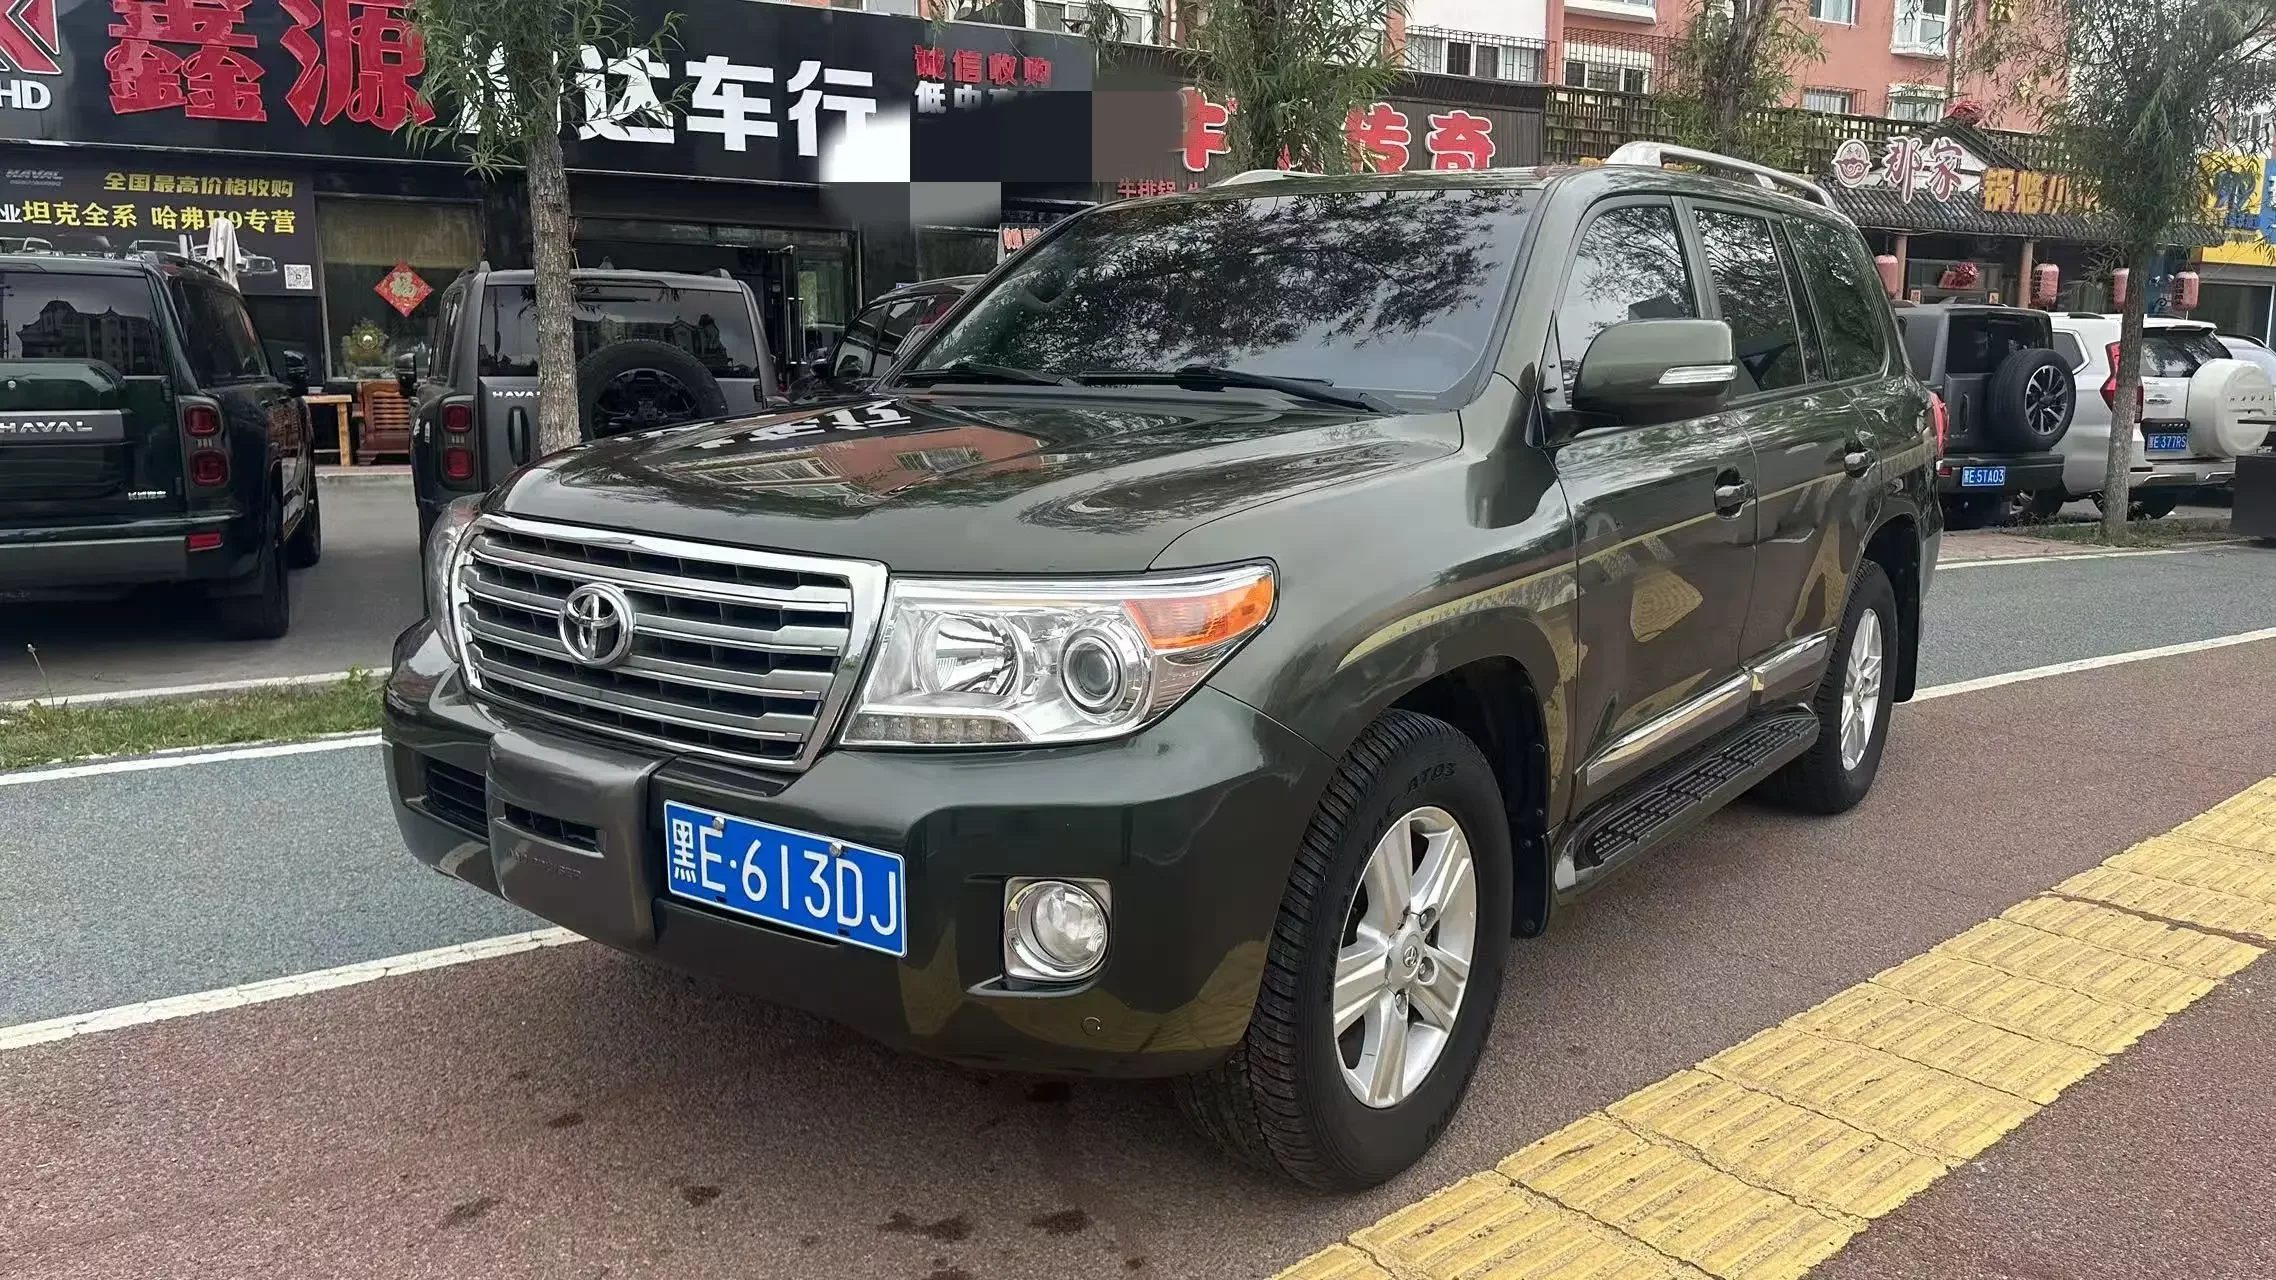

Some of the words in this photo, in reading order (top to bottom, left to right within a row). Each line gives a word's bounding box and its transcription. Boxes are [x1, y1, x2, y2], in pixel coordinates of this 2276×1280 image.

[914, 44, 1052, 88] 诚信收购
[103, 172, 294, 198] 全国最高价格收购
[1881, 135, 1963, 204] 那家
[0, 200, 138, 227] 业坦克全系
[151, 204, 296, 234] 哈弗H9专营
[492, 390, 541, 398] HAVA
[0, 420, 93, 433] HAVAL
[672, 817, 899, 937] 黑E·613DJ
